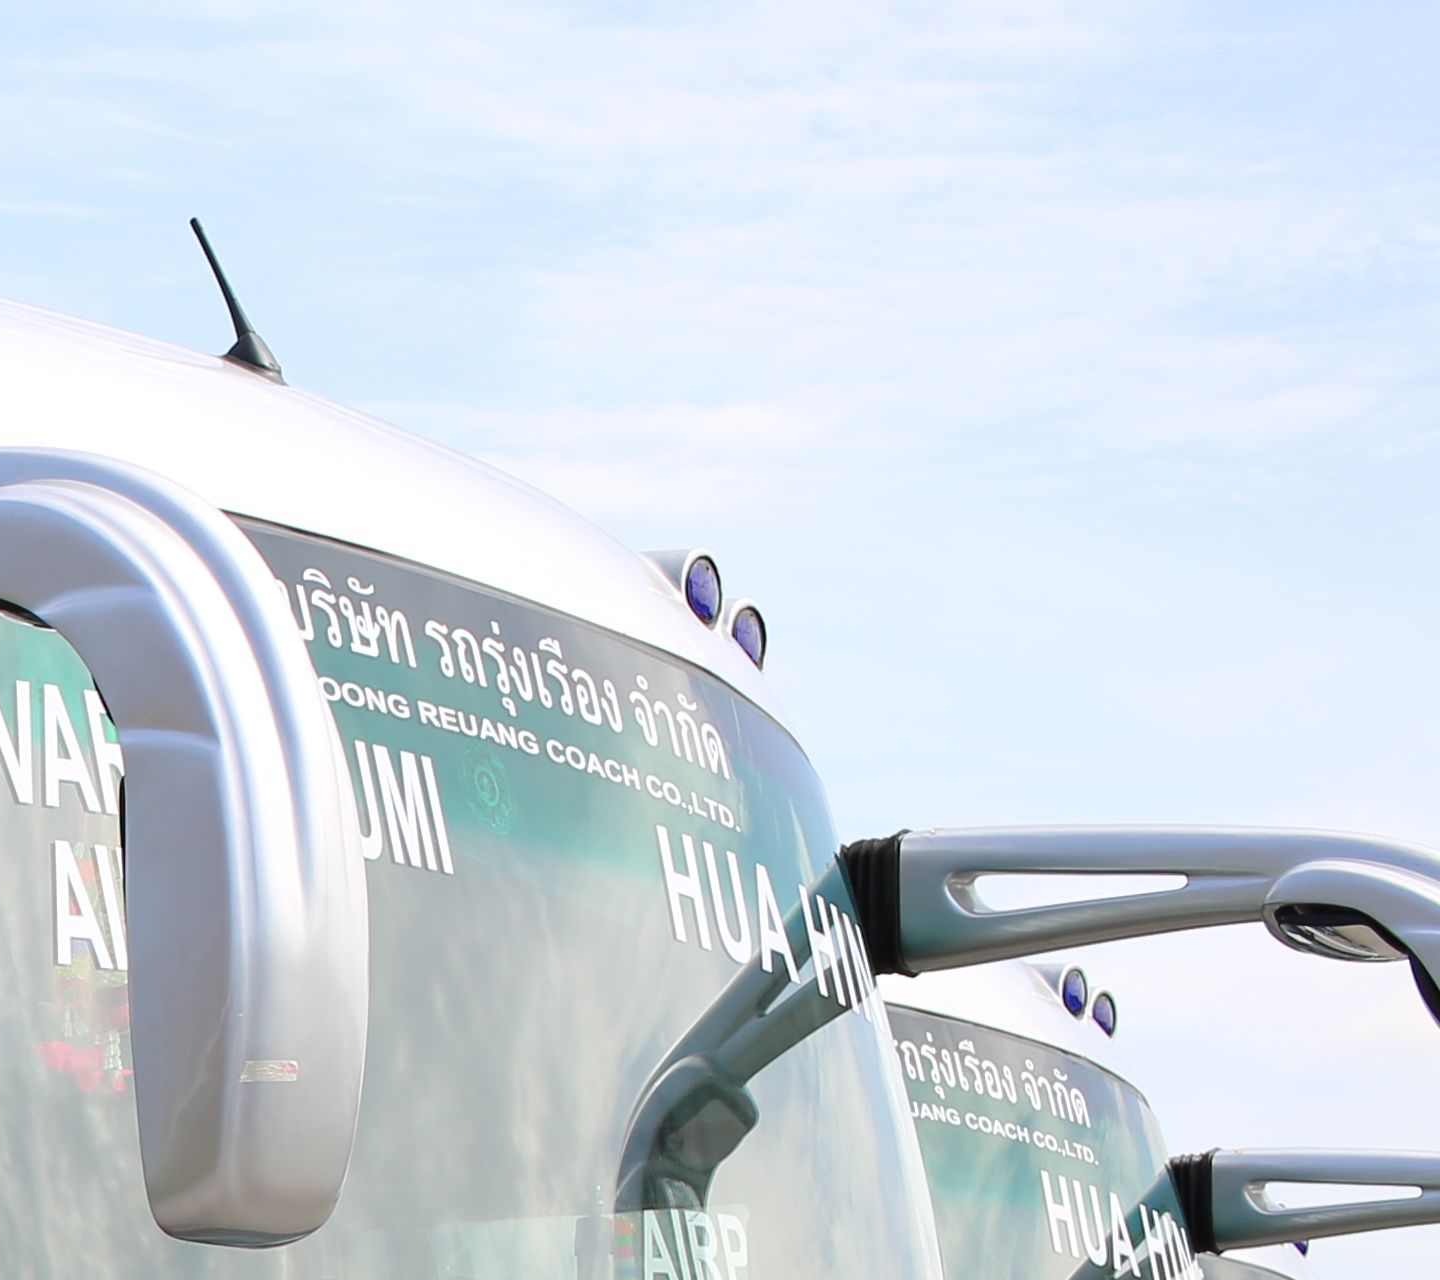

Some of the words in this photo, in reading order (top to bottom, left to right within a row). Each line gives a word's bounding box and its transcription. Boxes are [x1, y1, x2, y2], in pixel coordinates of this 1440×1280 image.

[424, 619, 624, 734] รถรุ่งเรือง
[629, 674, 733, 781] จำกัด
[417, 700, 541, 755] REUANG
[546, 737, 641, 792] COACH
[646, 773, 743, 834] CO.,LTD.
[655, 824, 801, 985] HUA
[798, 883, 888, 1033] HIN
[893, 1031, 1017, 1105] ถรุ่งเรือง
[1021, 1058, 1093, 1129] จำกัด
[965, 1111, 1030, 1144] COACH
[1033, 1130, 1100, 1166] CO.,LTD.
[1040, 1169, 1142, 1279] HUA
